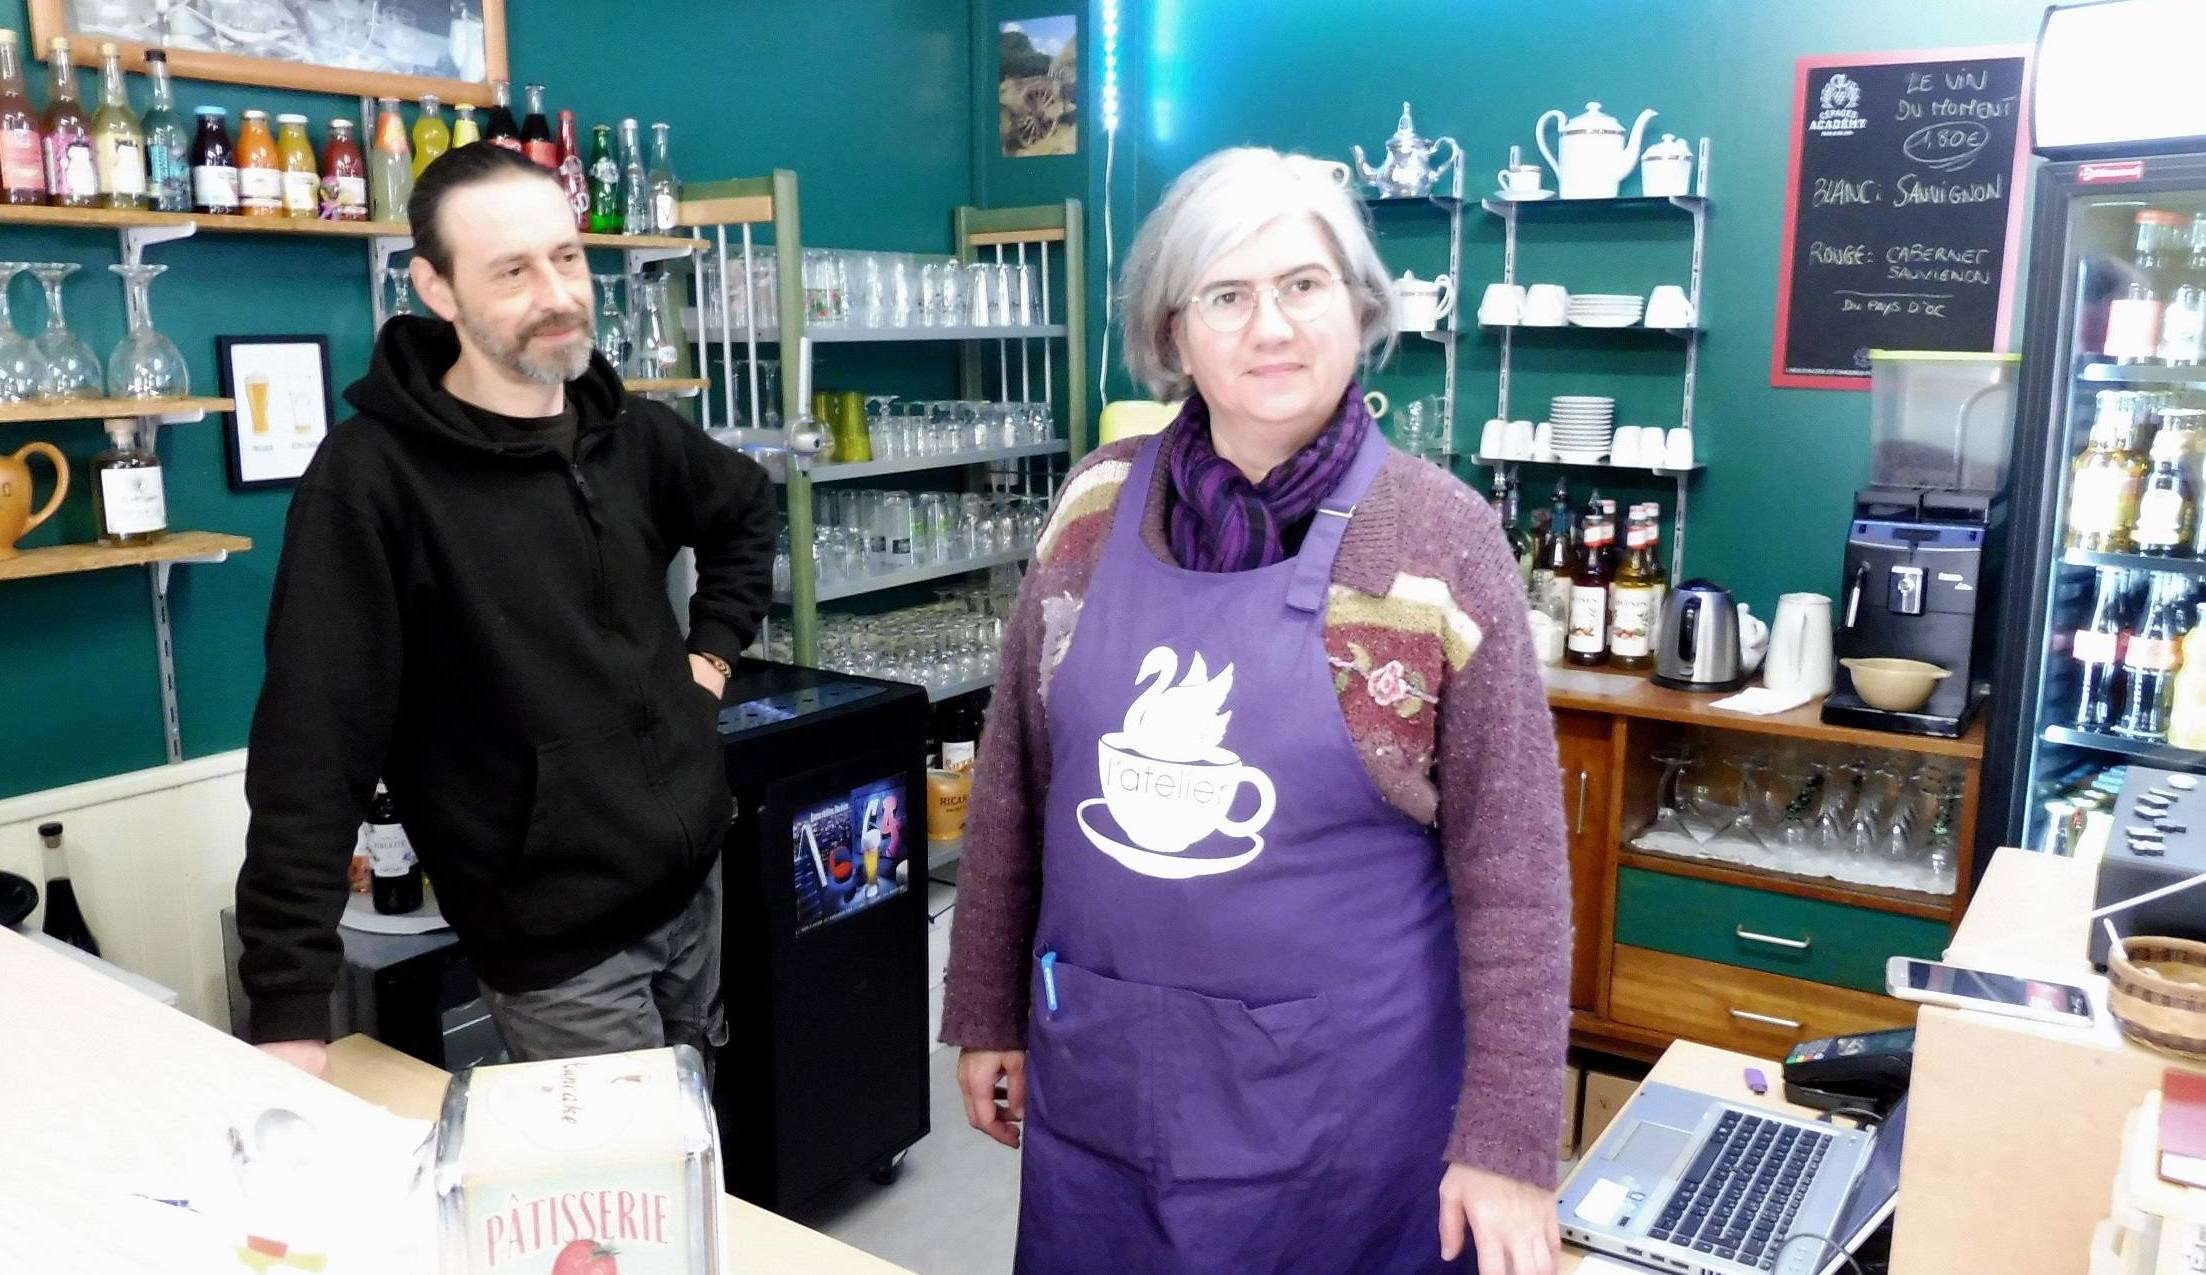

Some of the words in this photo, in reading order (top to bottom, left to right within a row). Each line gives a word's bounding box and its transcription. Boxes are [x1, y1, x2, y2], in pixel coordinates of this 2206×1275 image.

[1906, 71, 1934, 94] LE
[1895, 99, 1922, 120] DU
[1931, 96, 2017, 119] MOMENT
[1885, 243, 1991, 265] CABERNET
[1887, 266, 1991, 285] SAUVIGNON
[1106, 758, 1229, 805] l'atelier
[484, 1189, 670, 1267] PÂTISSERIE
